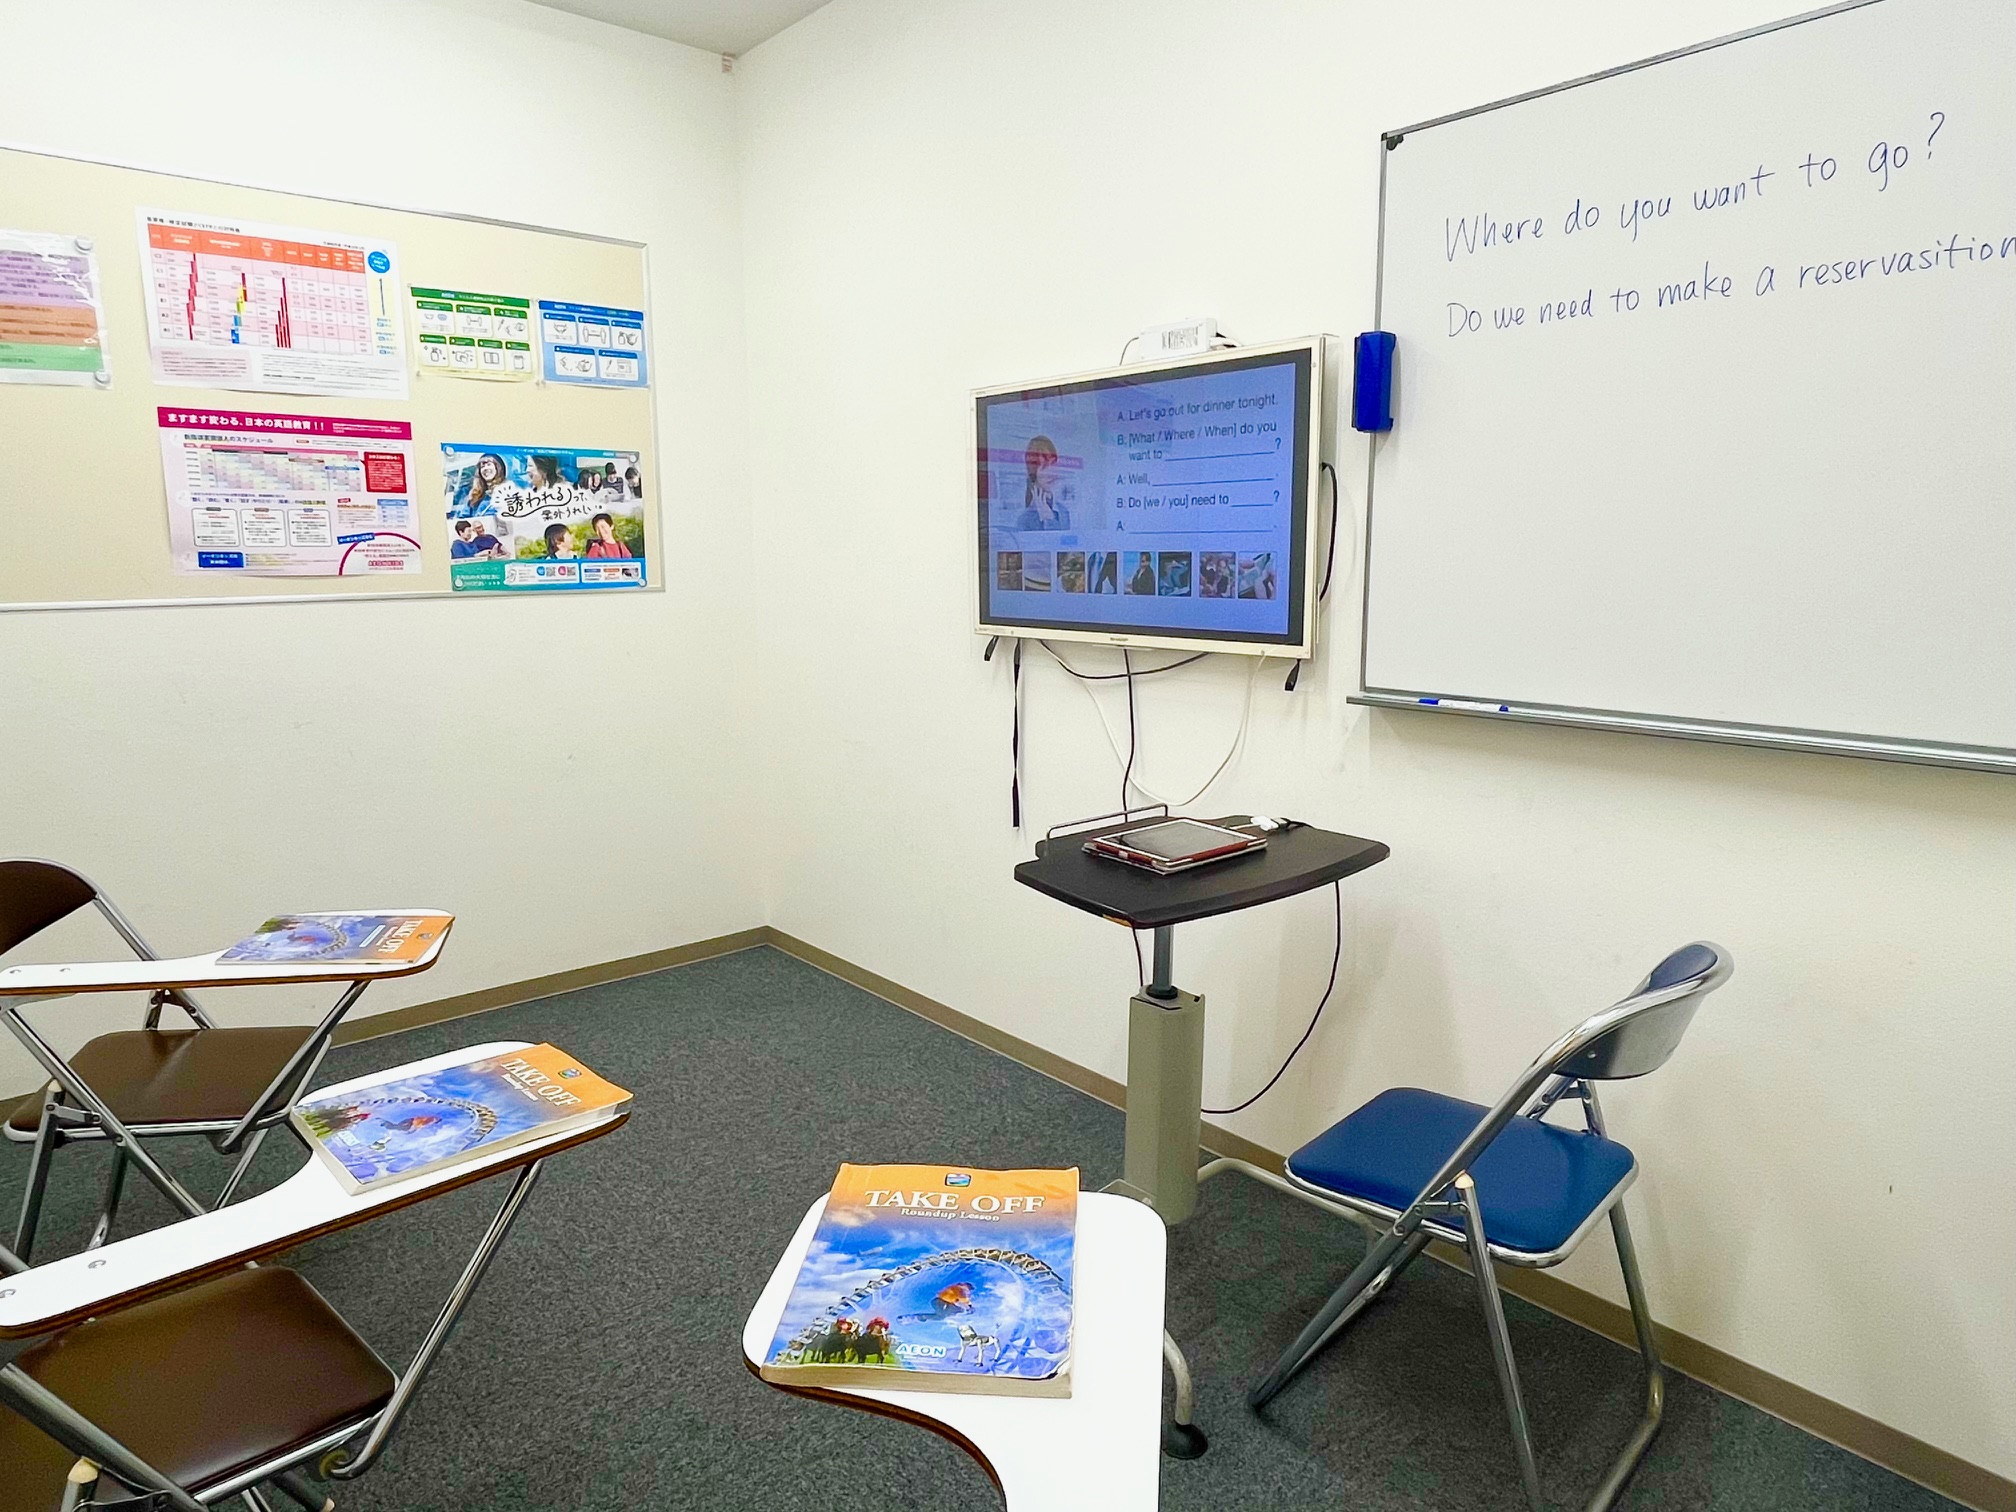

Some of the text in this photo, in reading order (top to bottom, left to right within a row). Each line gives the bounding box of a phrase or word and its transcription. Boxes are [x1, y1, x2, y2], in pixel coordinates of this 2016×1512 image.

[1446, 213, 1543, 262] Where
[1565, 199, 1599, 234] do
[1621, 197, 1671, 242] you
[1694, 165, 1775, 210] want
[1799, 153, 1836, 187] to
[1447, 234, 2016, 337] Do we need to make a reservasition
[1129, 409, 1150, 421] Let's
[1154, 408, 1166, 421] go
[1169, 404, 1185, 417] out
[1187, 402, 1199, 414] for
[1203, 399, 1236, 413] dinner
[1238, 393, 1278, 409] tonight.
[1129, 433, 1155, 448] [What
[1165, 428, 1195, 444] Where
[1205, 423, 1237, 438] When]
[1240, 422, 1253, 435] do
[1257, 422, 1277, 436] you
[1129, 437, 1282, 461] want to ?
[1128, 472, 1151, 486] Well,
[1129, 496, 1141, 508] Do
[1144, 496, 1160, 509] [we
[1169, 494, 1189, 509] you]
[1191, 494, 1216, 506] need
[1219, 494, 1229, 505] to
[1273, 490, 1280, 503] ?
[392, 920, 424, 938] TAKE
[377, 939, 405, 954] OFF
[500, 1058, 582, 1106] TAKE OFF
[864, 1189, 1046, 1214] TAKE OFF
[901, 1208, 1000, 1222] Roundup Lesson
[898, 1344, 946, 1357] AEON
